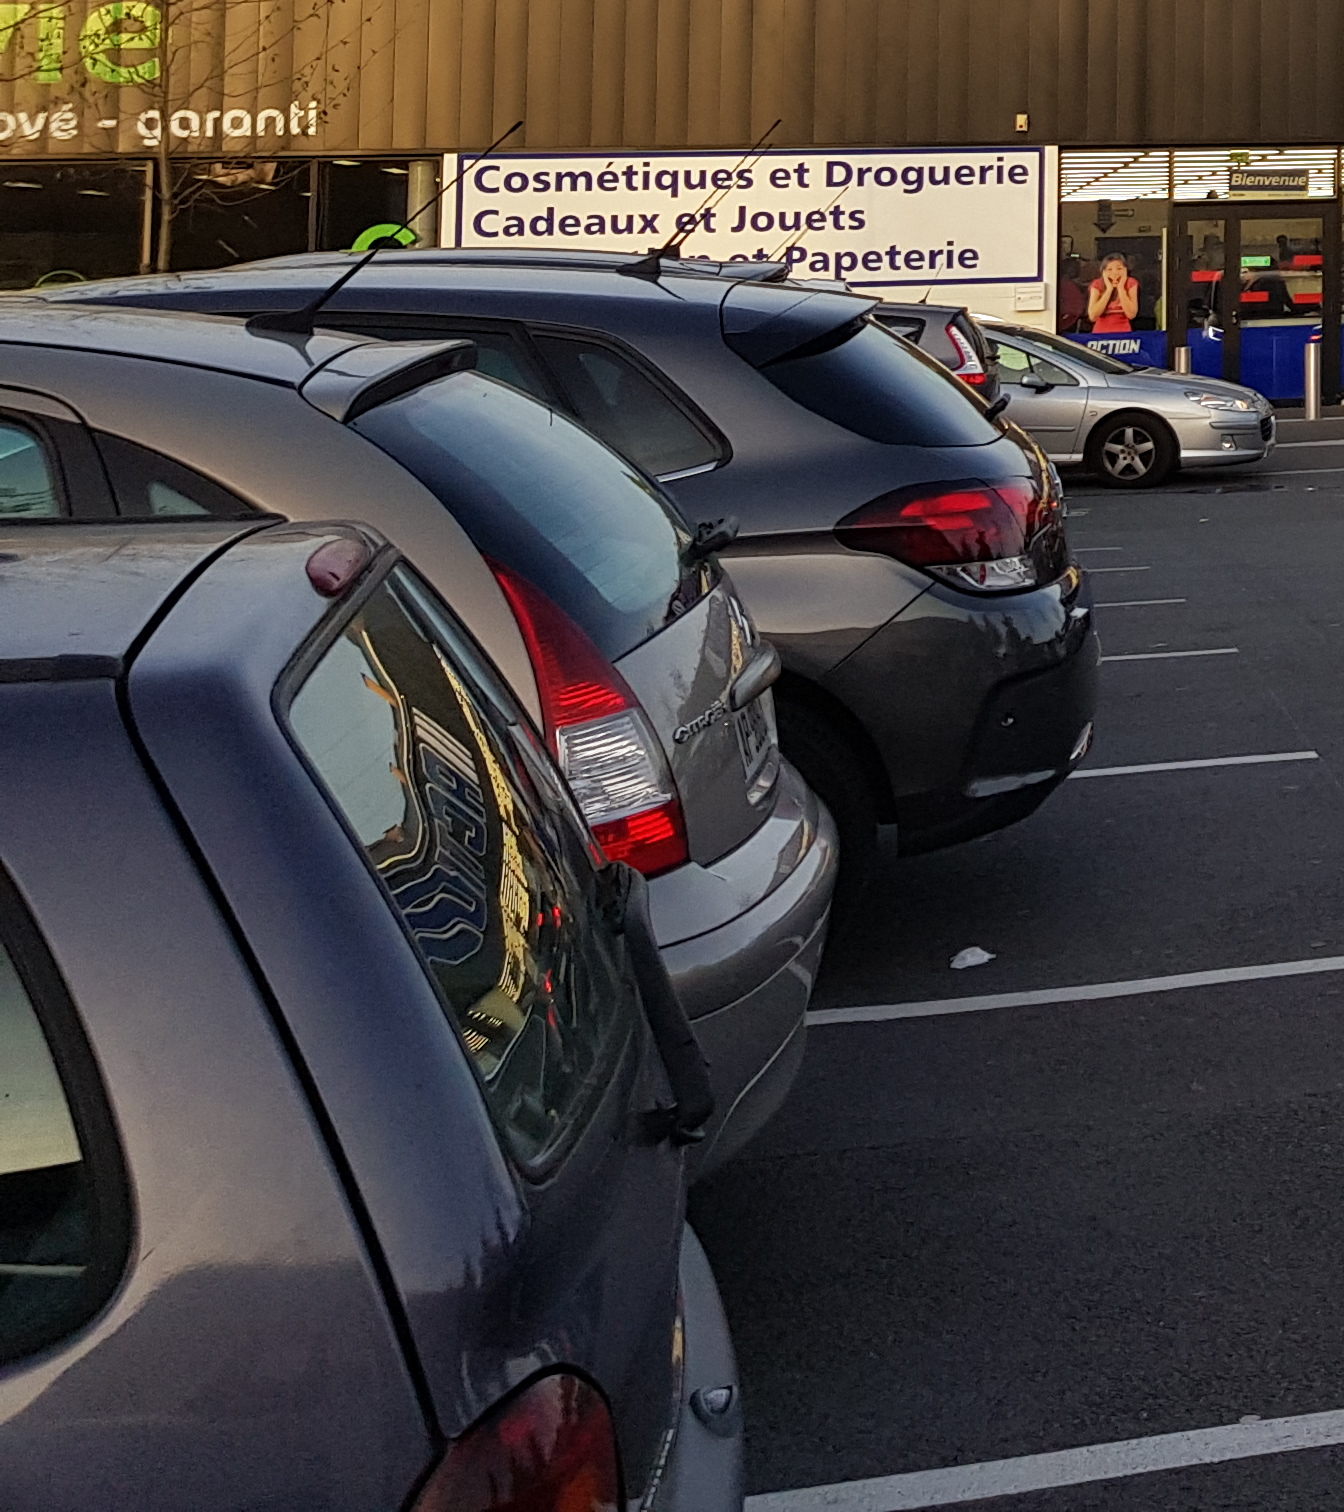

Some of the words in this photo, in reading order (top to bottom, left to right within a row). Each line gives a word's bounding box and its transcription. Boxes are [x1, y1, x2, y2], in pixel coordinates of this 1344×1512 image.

[137, 101, 319, 146] garanti
[473, 161, 754, 198] Cosmétiques
[769, 162, 811, 188] et
[825, 156, 1030, 194] Droguerie
[1230, 172, 1307, 187] Bienvenue
[473, 206, 661, 238] Cadeaux
[675, 206, 717, 234] et
[731, 204, 866, 233] Jouets
[785, 240, 980, 281] Papeterie
[1087, 339, 1141, 355] ACTION
